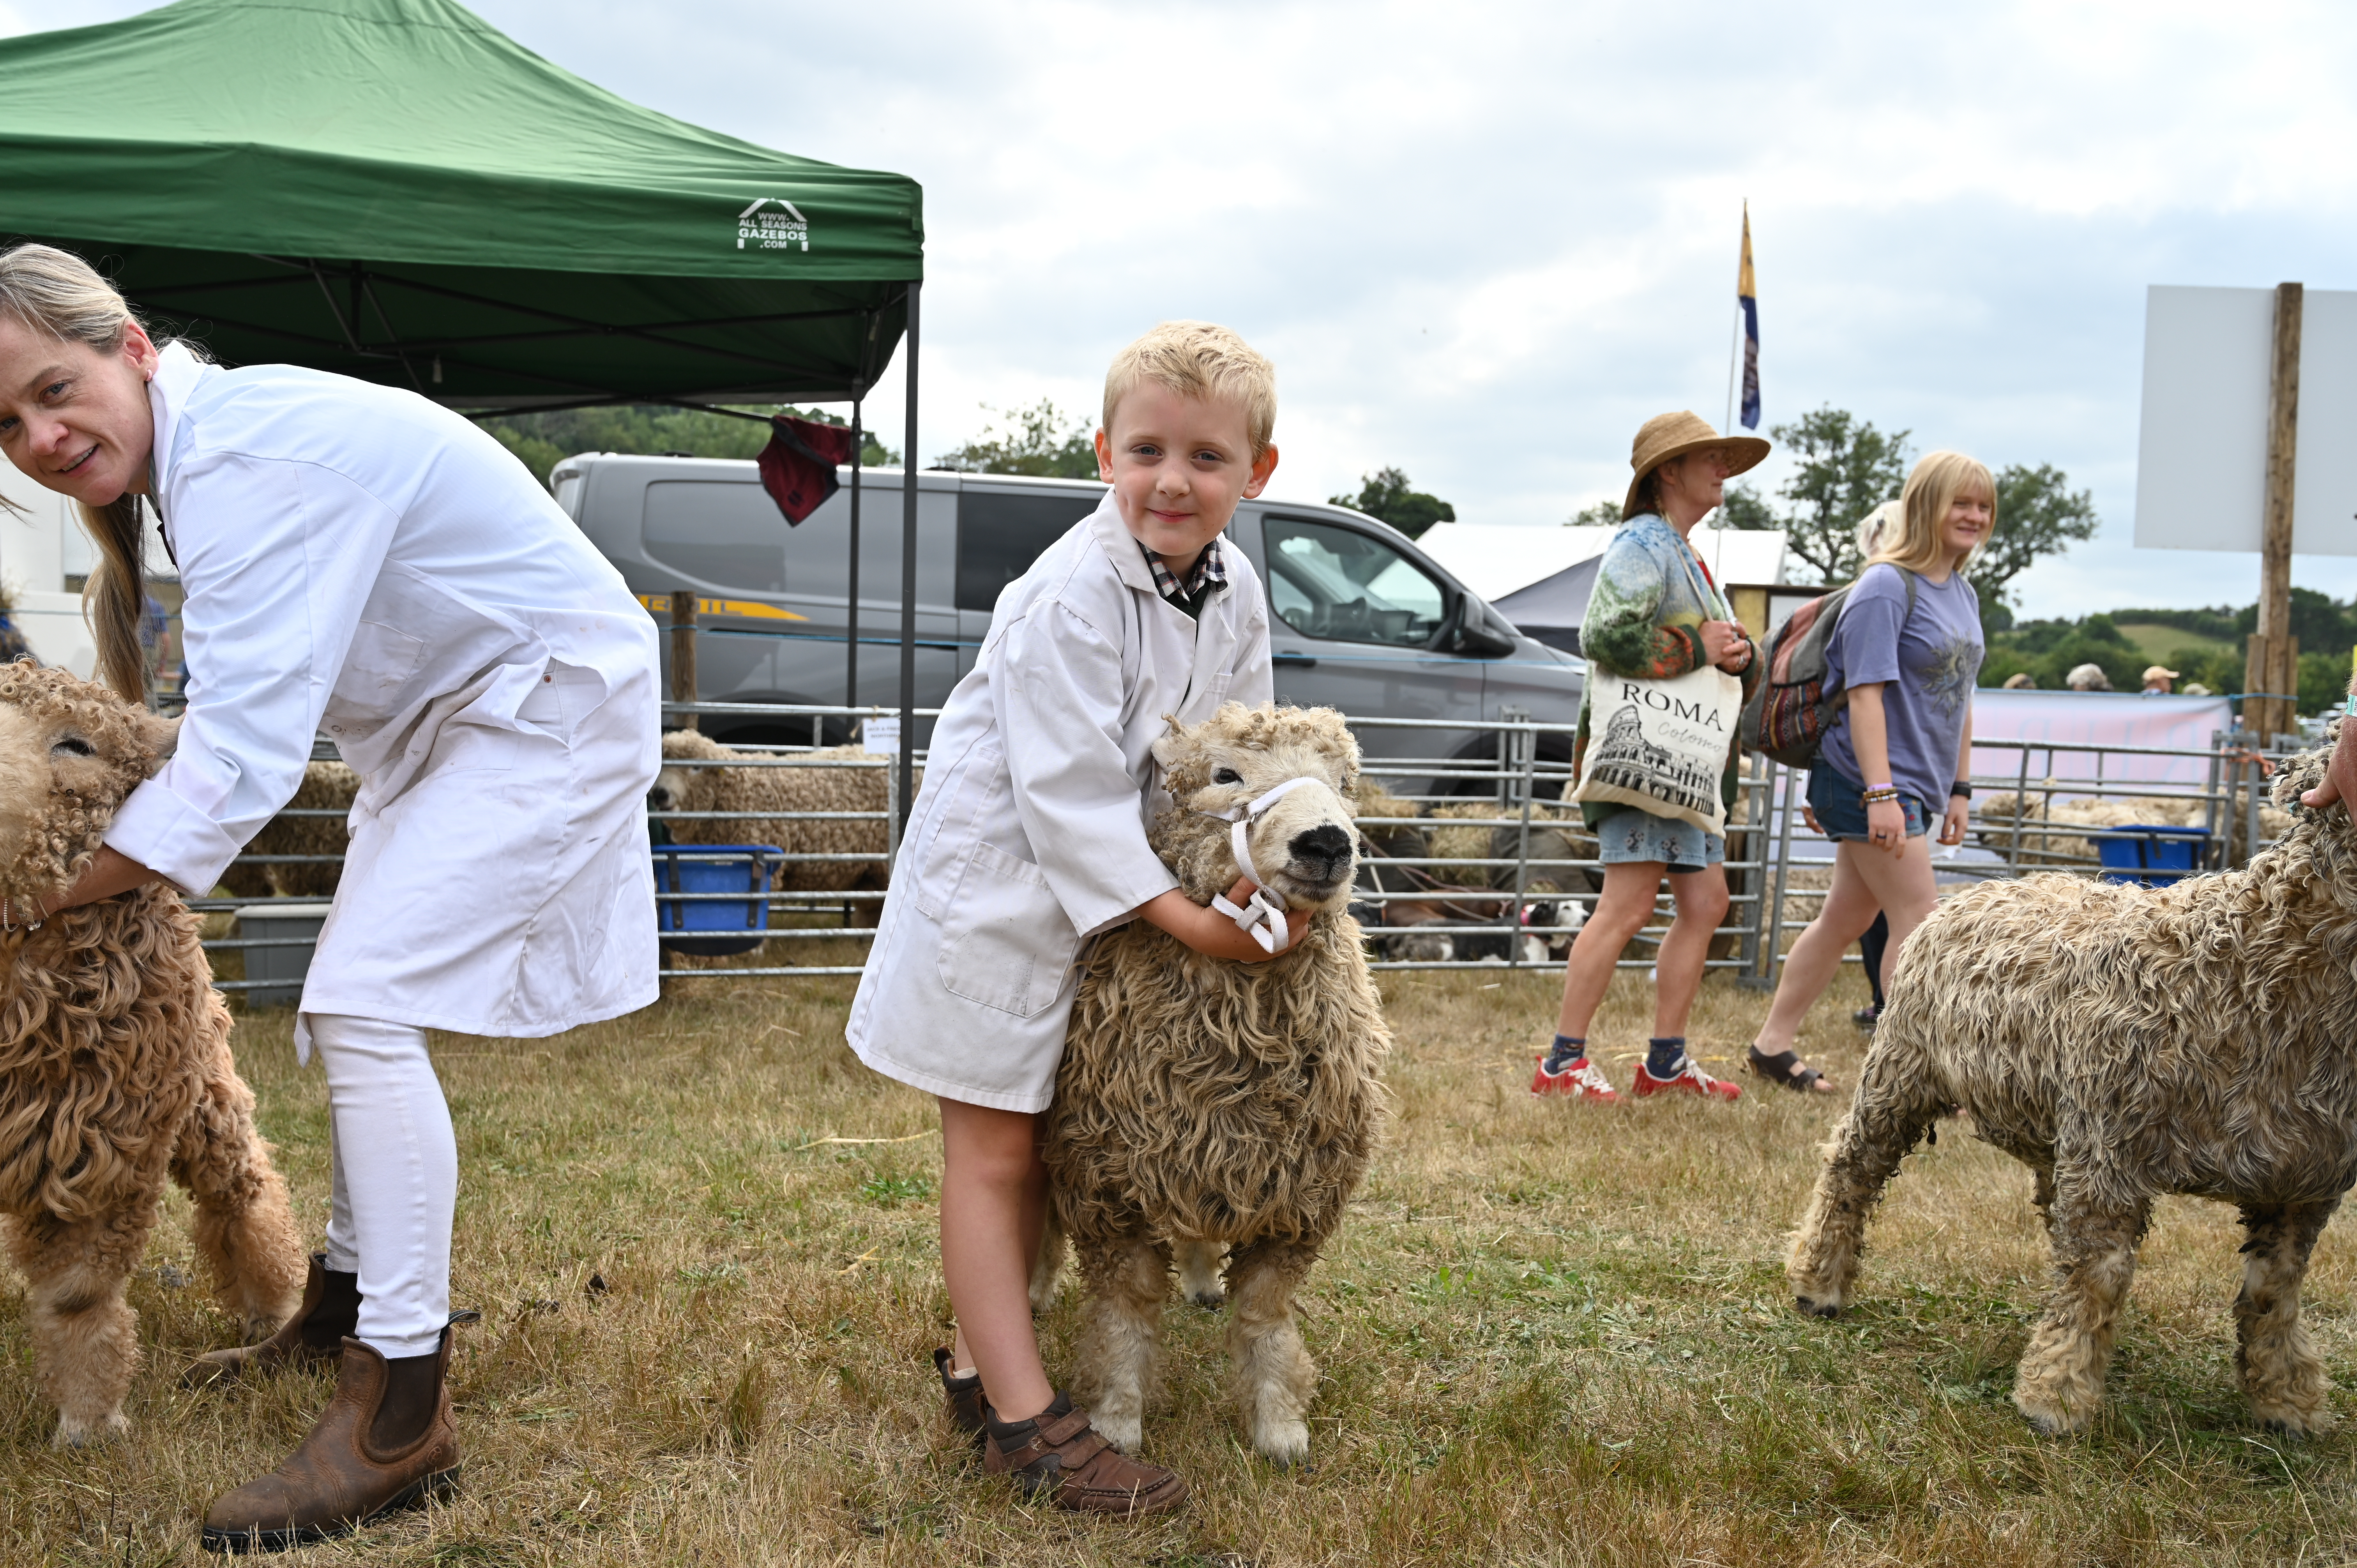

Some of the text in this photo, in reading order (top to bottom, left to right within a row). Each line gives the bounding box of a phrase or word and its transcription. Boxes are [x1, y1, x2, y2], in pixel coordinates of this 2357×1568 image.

[739, 219, 807, 230] ALL SEASONS
[739, 228, 807, 240] GAZEBOS
[760, 240, 787, 249] .COM
[1621, 683, 1725, 732] ROMA
